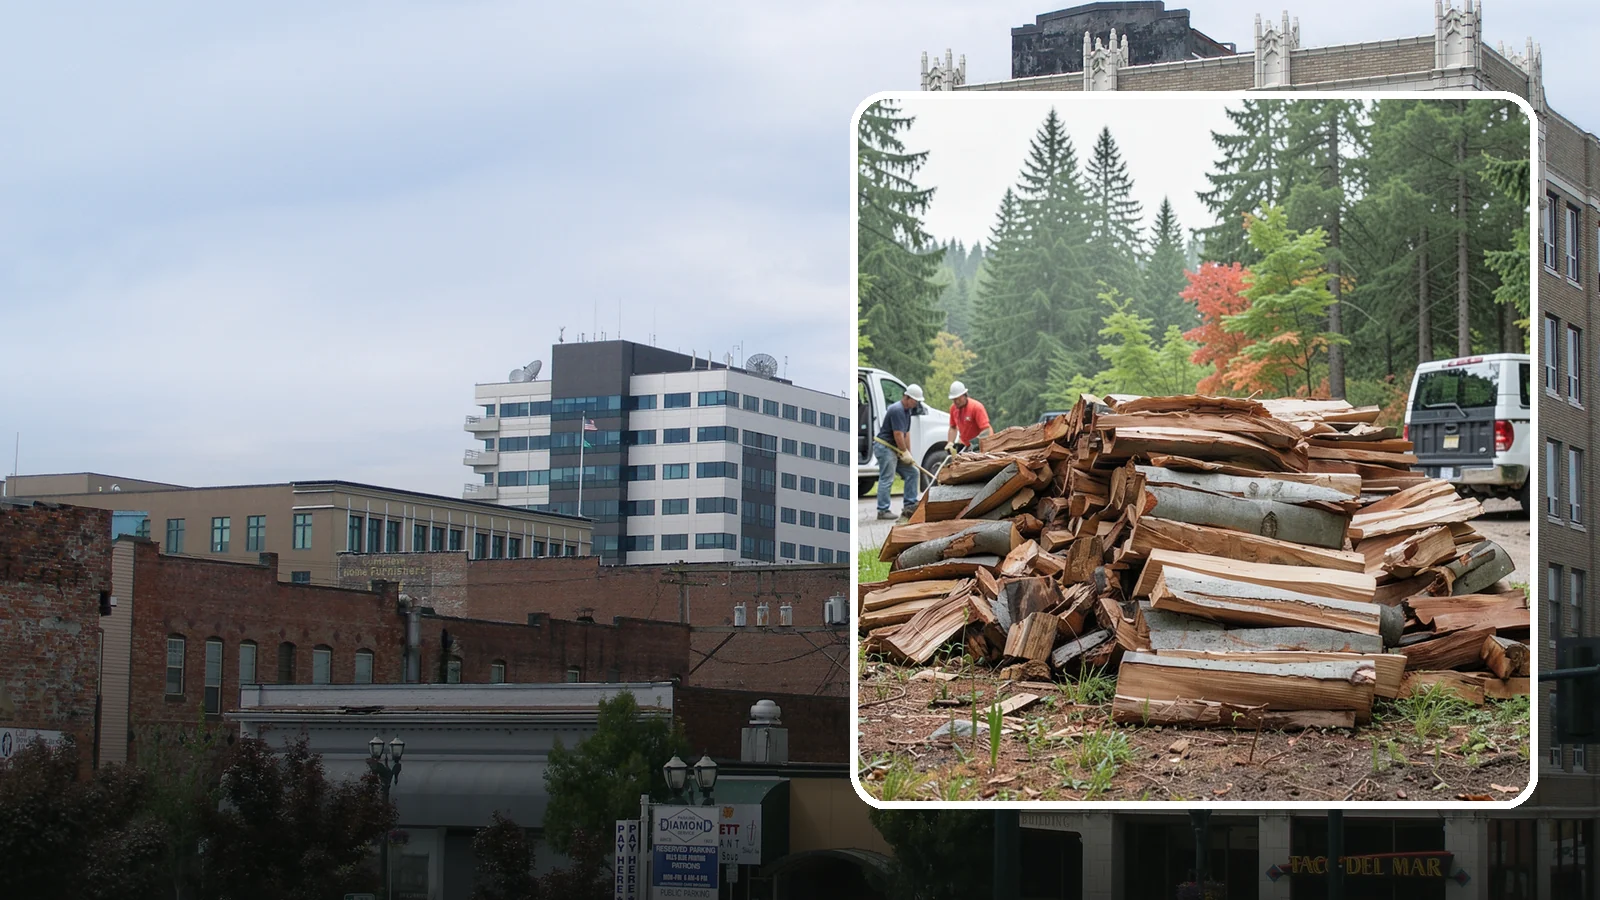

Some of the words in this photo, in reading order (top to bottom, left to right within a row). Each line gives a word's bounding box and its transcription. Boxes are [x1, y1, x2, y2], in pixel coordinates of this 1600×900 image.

[370, 566, 427, 576] Furnishers
[660, 818, 713, 832] DIAMOND
[1022, 816, 1070, 828] BUILDING
[617, 825, 625, 852] PAY
[628, 825, 636, 852] PAY
[656, 845, 688, 853] RESERVED
[689, 846, 716, 854] PARKING
[721, 851, 739, 862] Soup
[671, 862, 701, 870] PATRONS
[1346, 856, 1385, 876] DEL
[1392, 857, 1442, 877] MAR
[616, 856, 625, 893] HERE
[628, 856, 636, 893] HERE
[660, 888, 682, 897] PUBLIC
[683, 889, 710, 898] PARKING
